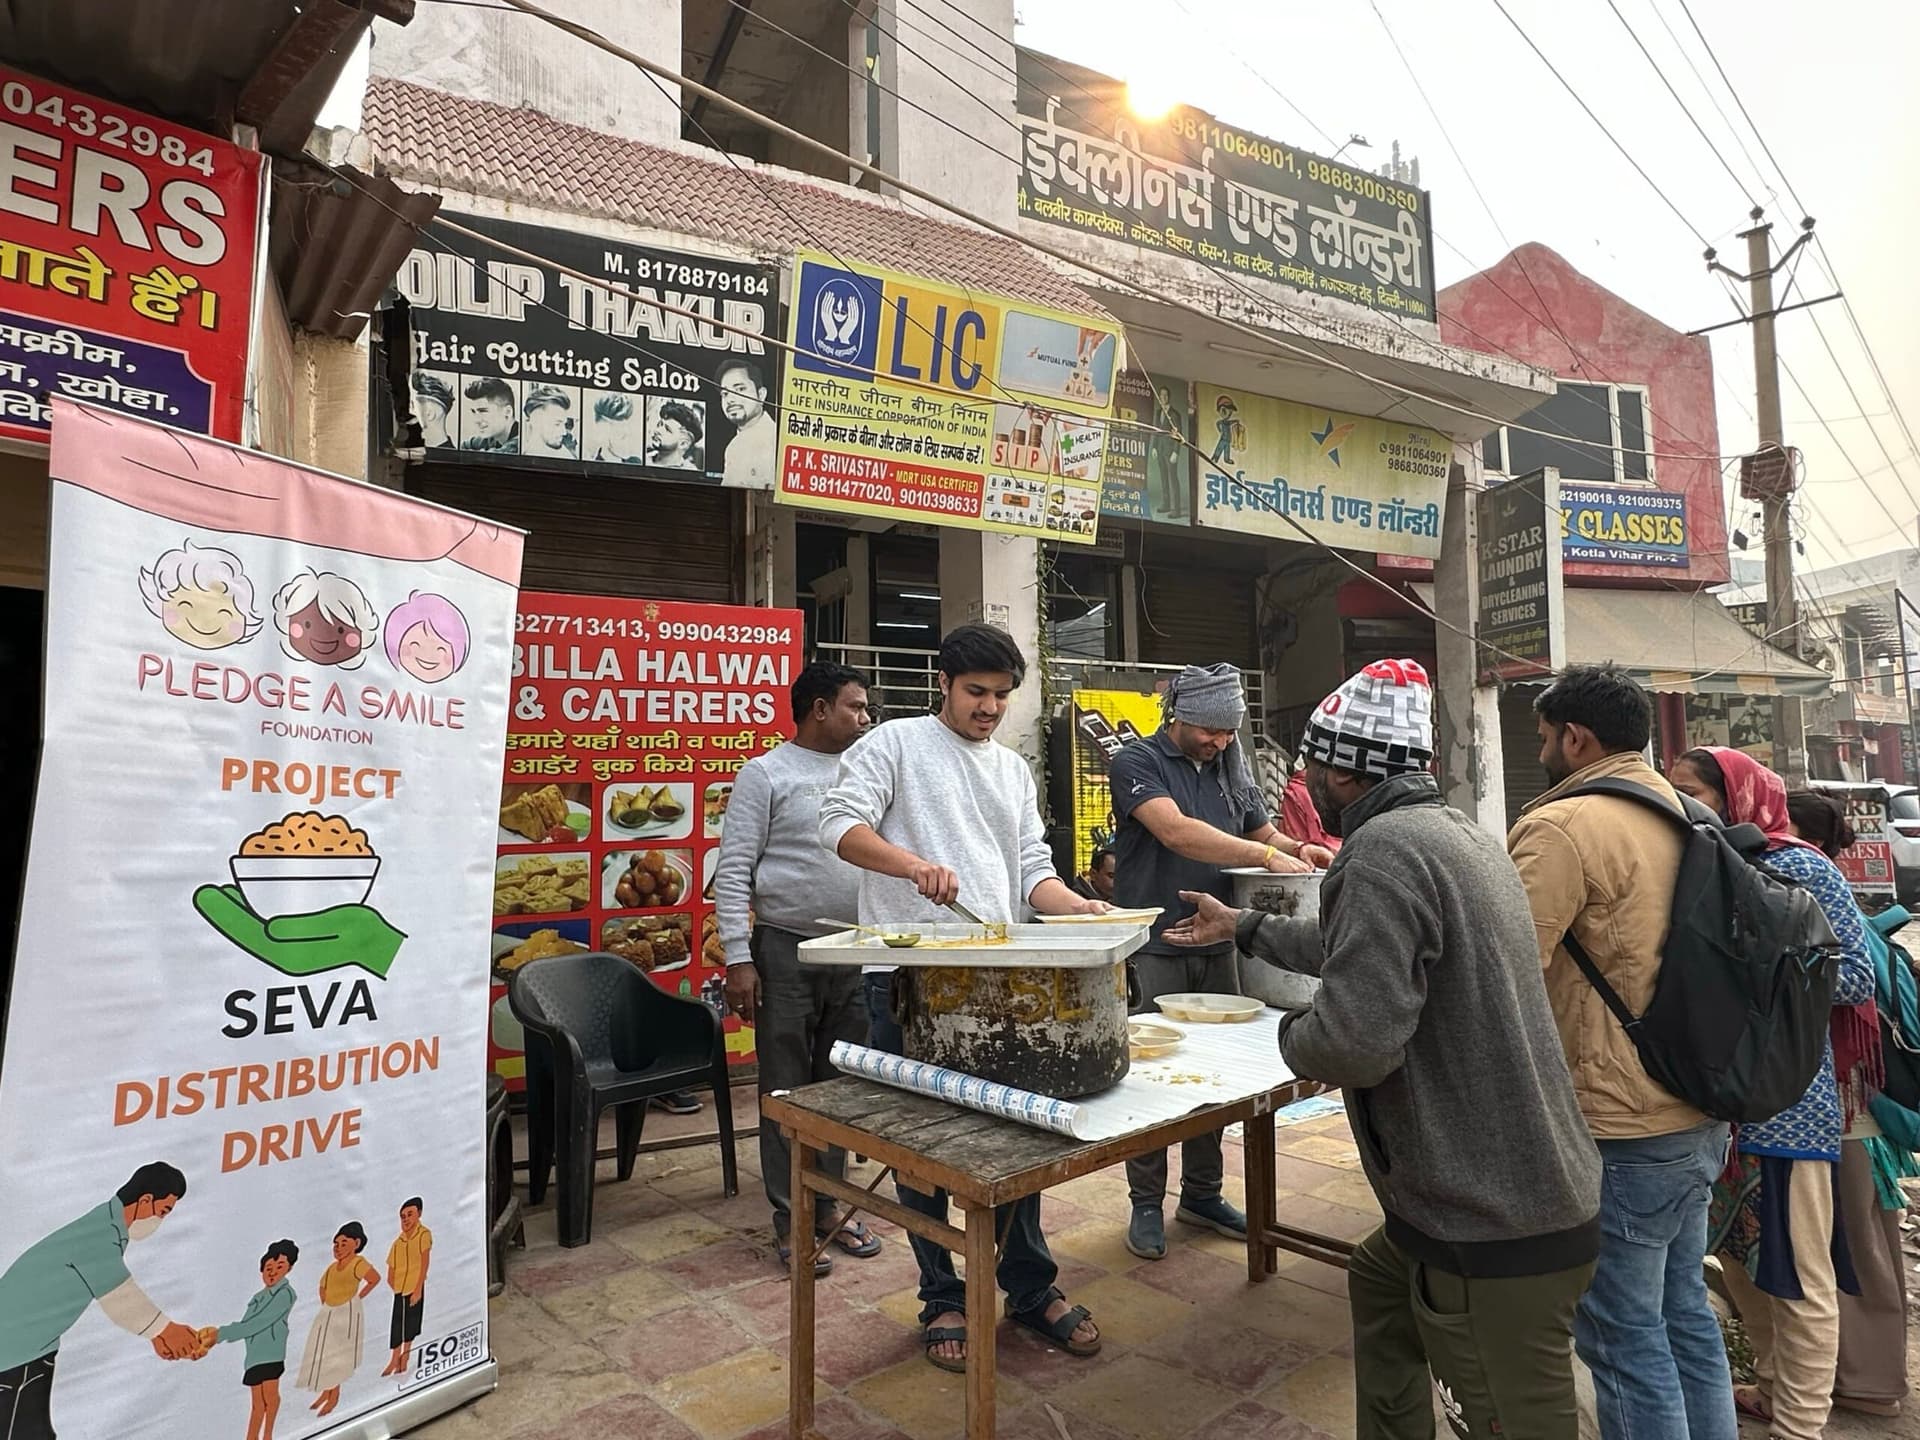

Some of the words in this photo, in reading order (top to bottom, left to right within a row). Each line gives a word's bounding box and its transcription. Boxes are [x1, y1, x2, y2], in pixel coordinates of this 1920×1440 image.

[1308, 159, 1418, 212] 9868300360
[1223, 180, 1299, 258] एण्ड
[604, 251, 630, 277] M.
[637, 260, 770, 297] 8178879184
[560, 272, 766, 356] THAKUR
[890, 296, 986, 391] LIC
[486, 341, 610, 386] Cutting
[621, 358, 700, 394] Salon
[789, 394, 812, 408] LIFE
[815, 398, 874, 419] INSURANCE
[876, 409, 944, 432] CORPORATION
[947, 422, 959, 432] OF
[962, 425, 987, 438] INDIA
[792, 377, 851, 400] भारतीय
[859, 388, 903, 409] जीवन
[911, 396, 942, 416] बीमा
[951, 402, 988, 425] निगम
[788, 413, 811, 437] किसी
[812, 417, 823, 439] भी
[825, 425, 847, 443] प्रकार
[848, 424, 858, 443] के
[1075, 431, 1101, 444] HEALTH
[790, 449, 801, 467] P.
[805, 452, 817, 471] K.
[821, 455, 888, 481] SRIVASTAV
[921, 474, 936, 488] USA
[938, 476, 979, 494] CERTIFIED
[1063, 448, 1102, 466] INSURANCE
[1106, 454, 1133, 469] PERS
[1388, 458, 1446, 478] 9868300360
[1389, 443, 1447, 464] 9811064901
[787, 472, 805, 490] M.
[809, 475, 895, 505] 9811477020,
[900, 488, 978, 514] 9010398633
[1205, 470, 1326, 521] ड्राईक्लीनर्स
[1331, 495, 1372, 529] एण्ड
[1378, 497, 1439, 538] लॉन्डरी
[1618, 495, 1682, 510] 9210039375
[1480, 525, 1543, 561] K-STAR
[1578, 509, 1684, 546] CLASSES
[1482, 548, 1544, 582] LAUNDRY
[1571, 548, 1605, 559] Kotla
[1608, 549, 1645, 561] Vihar
[1482, 581, 1546, 610] DRYCLEANING
[1491, 602, 1537, 626] SERVICES
[658, 622, 791, 645] 9990432984
[638, 650, 790, 686] HALWAI
[138, 653, 310, 712] PLEDGE
[322, 681, 347, 717] A
[359, 686, 465, 729] SMILE
[515, 686, 546, 721] &
[562, 687, 776, 724] CATERERS
[260, 720, 373, 745] FOUNDATION
[571, 725, 622, 751] यहाँ
[626, 730, 681, 750] शादी
[686, 736, 705, 750] व
[711, 730, 756, 750] पार्टी
[221, 757, 402, 804] PROJECT
[592, 759, 637, 781] बुक
[643, 753, 695, 773] किये
[221, 979, 377, 1039] SEVA
[114, 1036, 440, 1127] DISTRIBUTION
[221, 1108, 362, 1173] DRIVE
[415, 1346, 479, 1380] CERTIFIED
[417, 1336, 458, 1369] ISO
